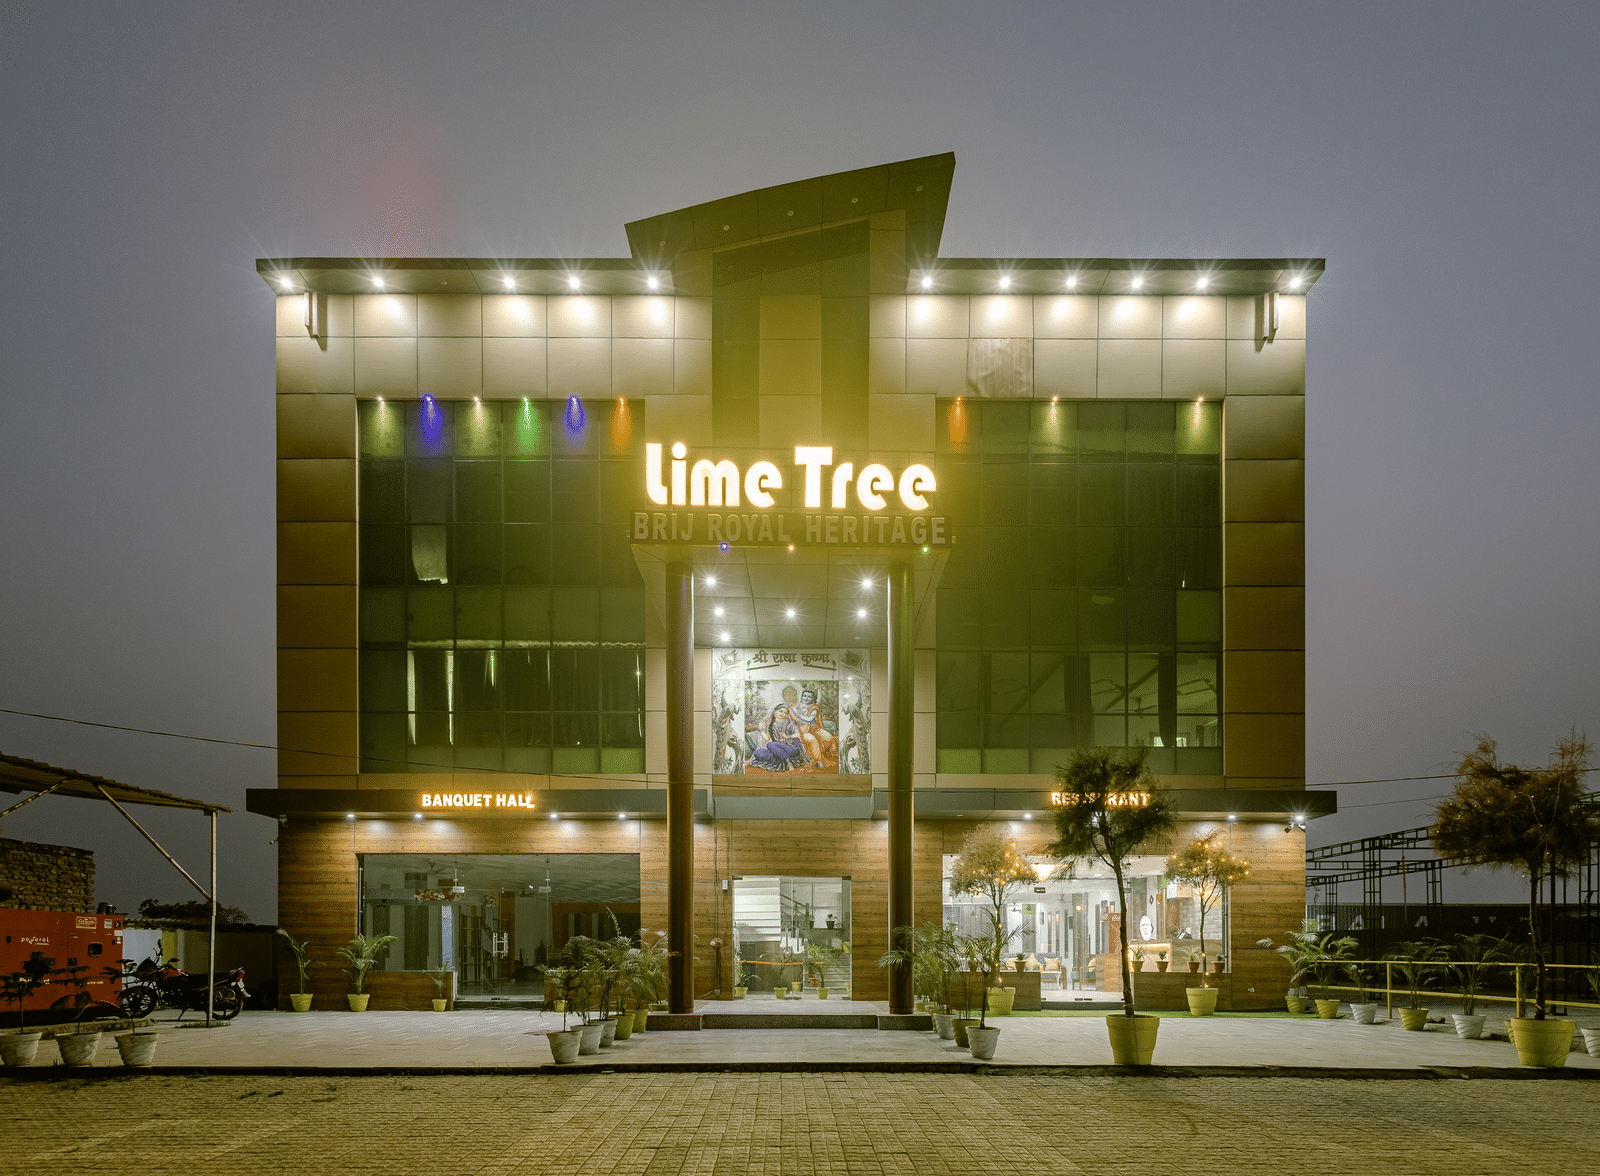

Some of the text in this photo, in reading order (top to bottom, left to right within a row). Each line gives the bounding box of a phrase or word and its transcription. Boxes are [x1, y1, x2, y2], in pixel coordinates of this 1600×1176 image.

[645, 441, 937, 511] Lime Tree
[634, 512, 946, 544] BRIJ ROYAL HERITAGE
[752, 650, 769, 664] श्री
[771, 653, 798, 664] राधा
[421, 793, 536, 809] BANQUET HALL
[1050, 791, 1150, 806] RESRANT
